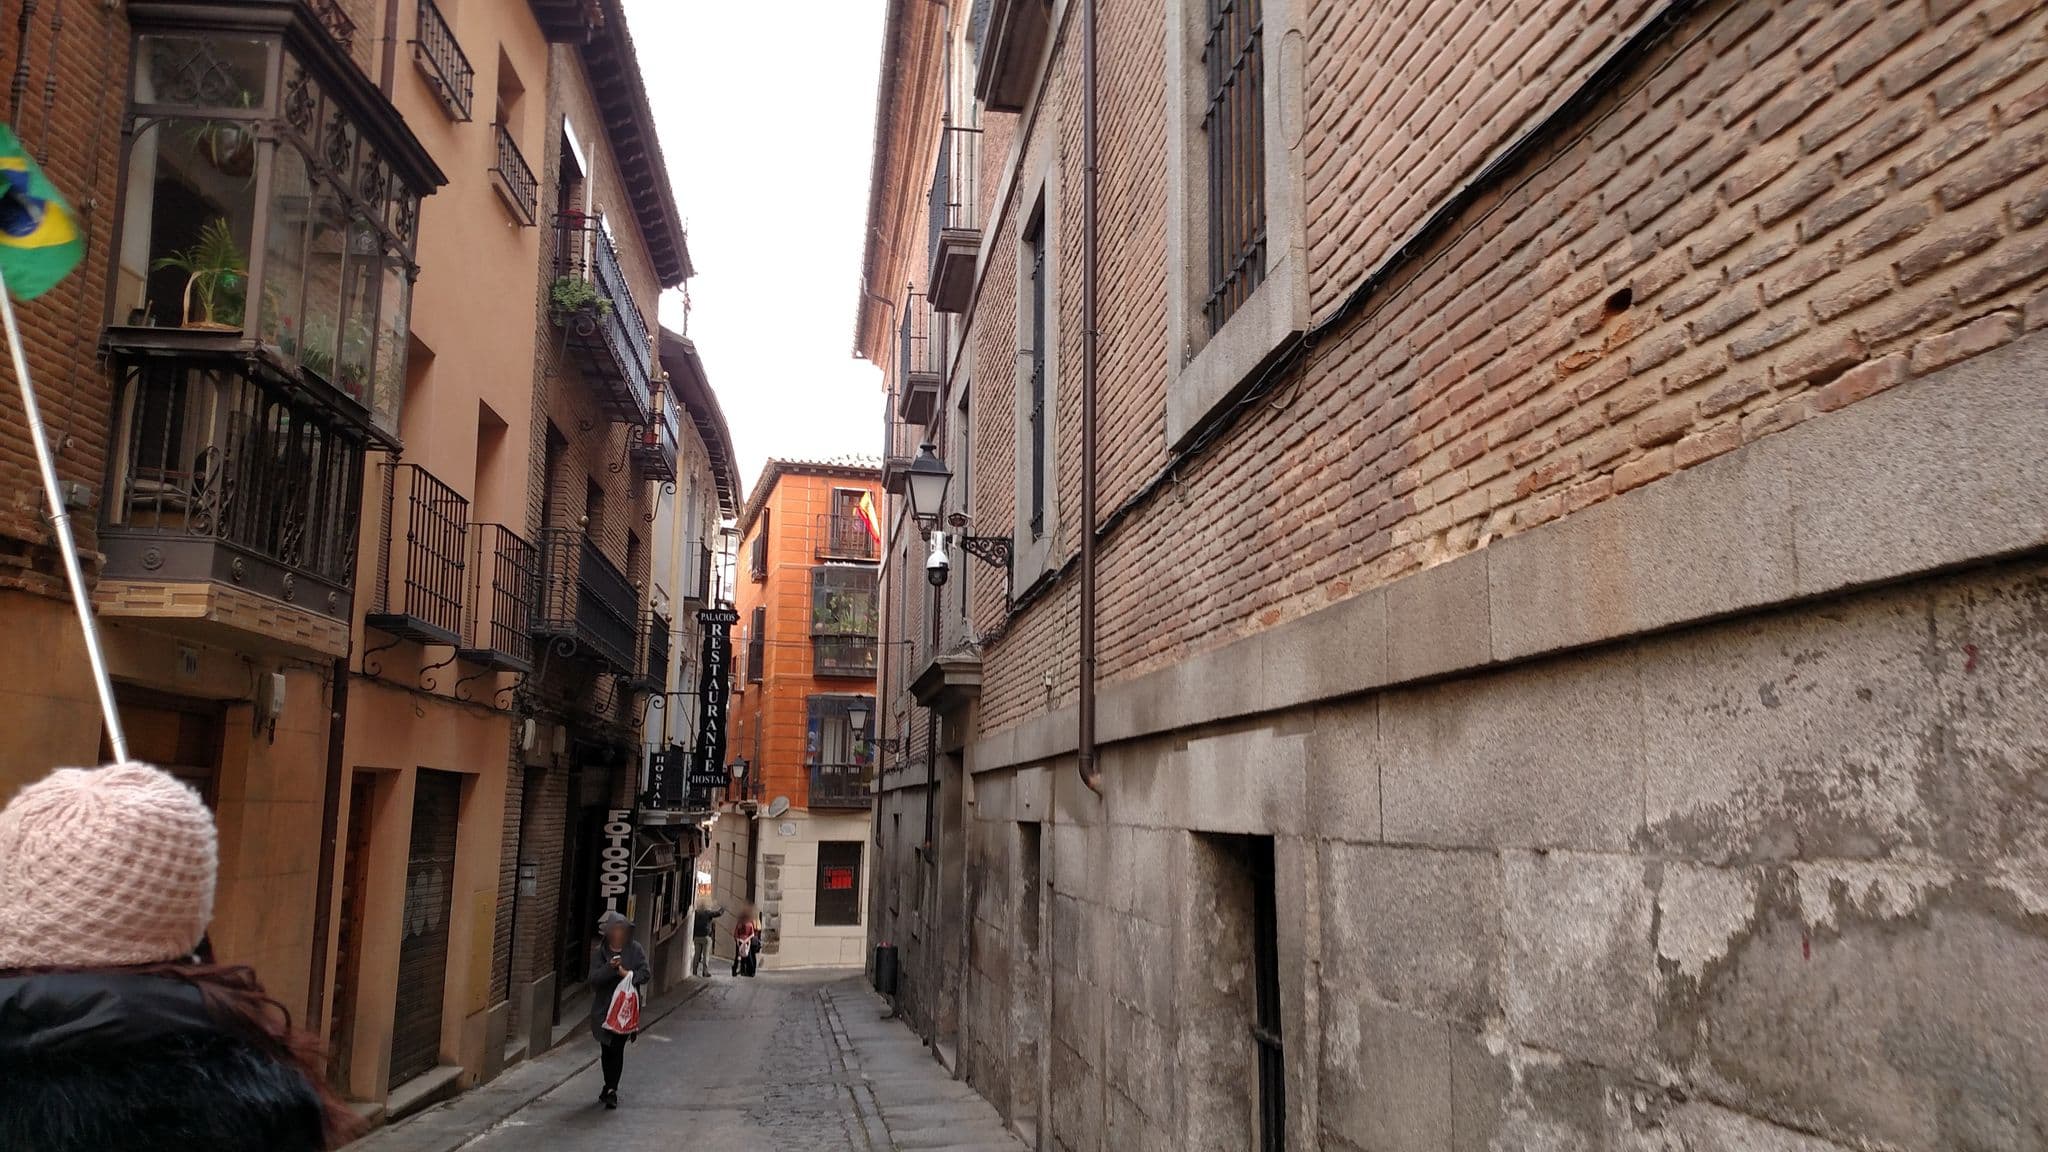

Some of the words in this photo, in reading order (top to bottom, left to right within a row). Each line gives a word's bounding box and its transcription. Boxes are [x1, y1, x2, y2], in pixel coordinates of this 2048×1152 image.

[701, 613, 735, 621] PALACIOS
[705, 623, 722, 772] RESTAURANTE
[653, 755, 664, 808] HOSTAL
[691, 775, 726, 785] HOSTAL
